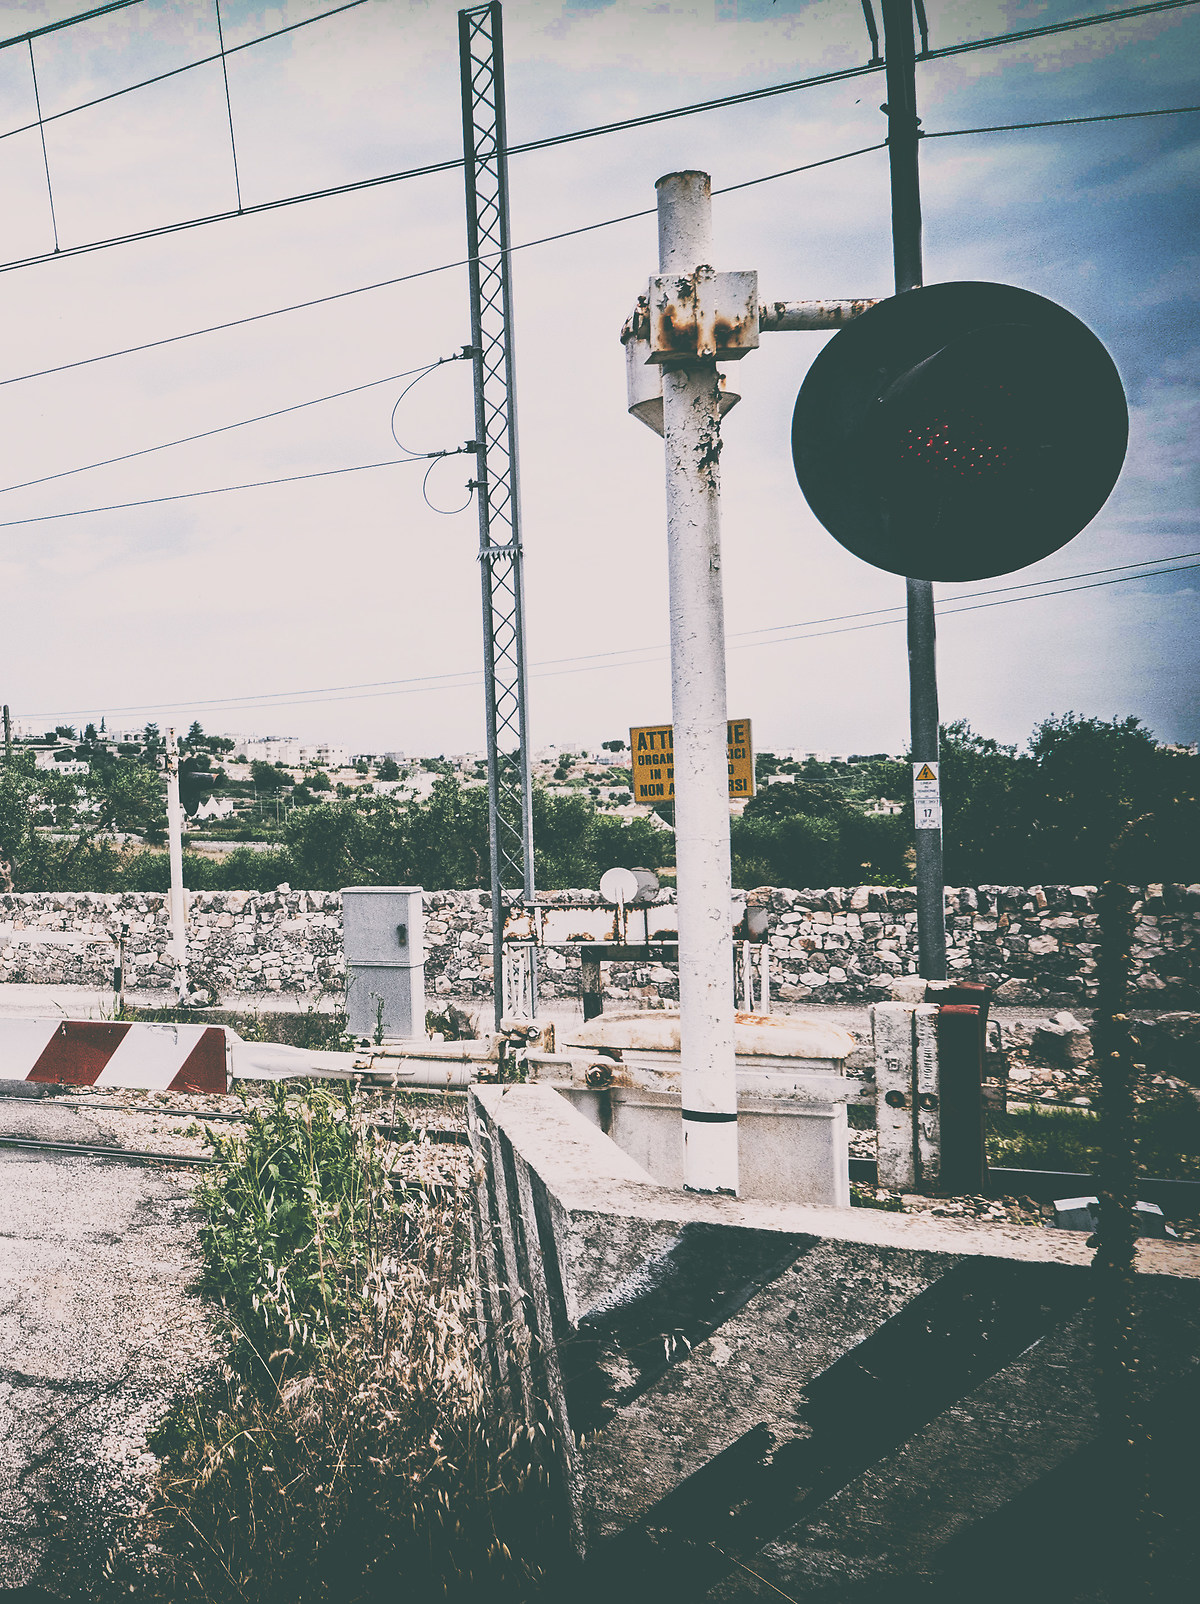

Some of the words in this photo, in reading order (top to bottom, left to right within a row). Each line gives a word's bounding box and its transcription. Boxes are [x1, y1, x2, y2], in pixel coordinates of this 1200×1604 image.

[650, 768, 662, 780] IN
[640, 783, 664, 797] NON
[924, 808, 932, 818] 17
